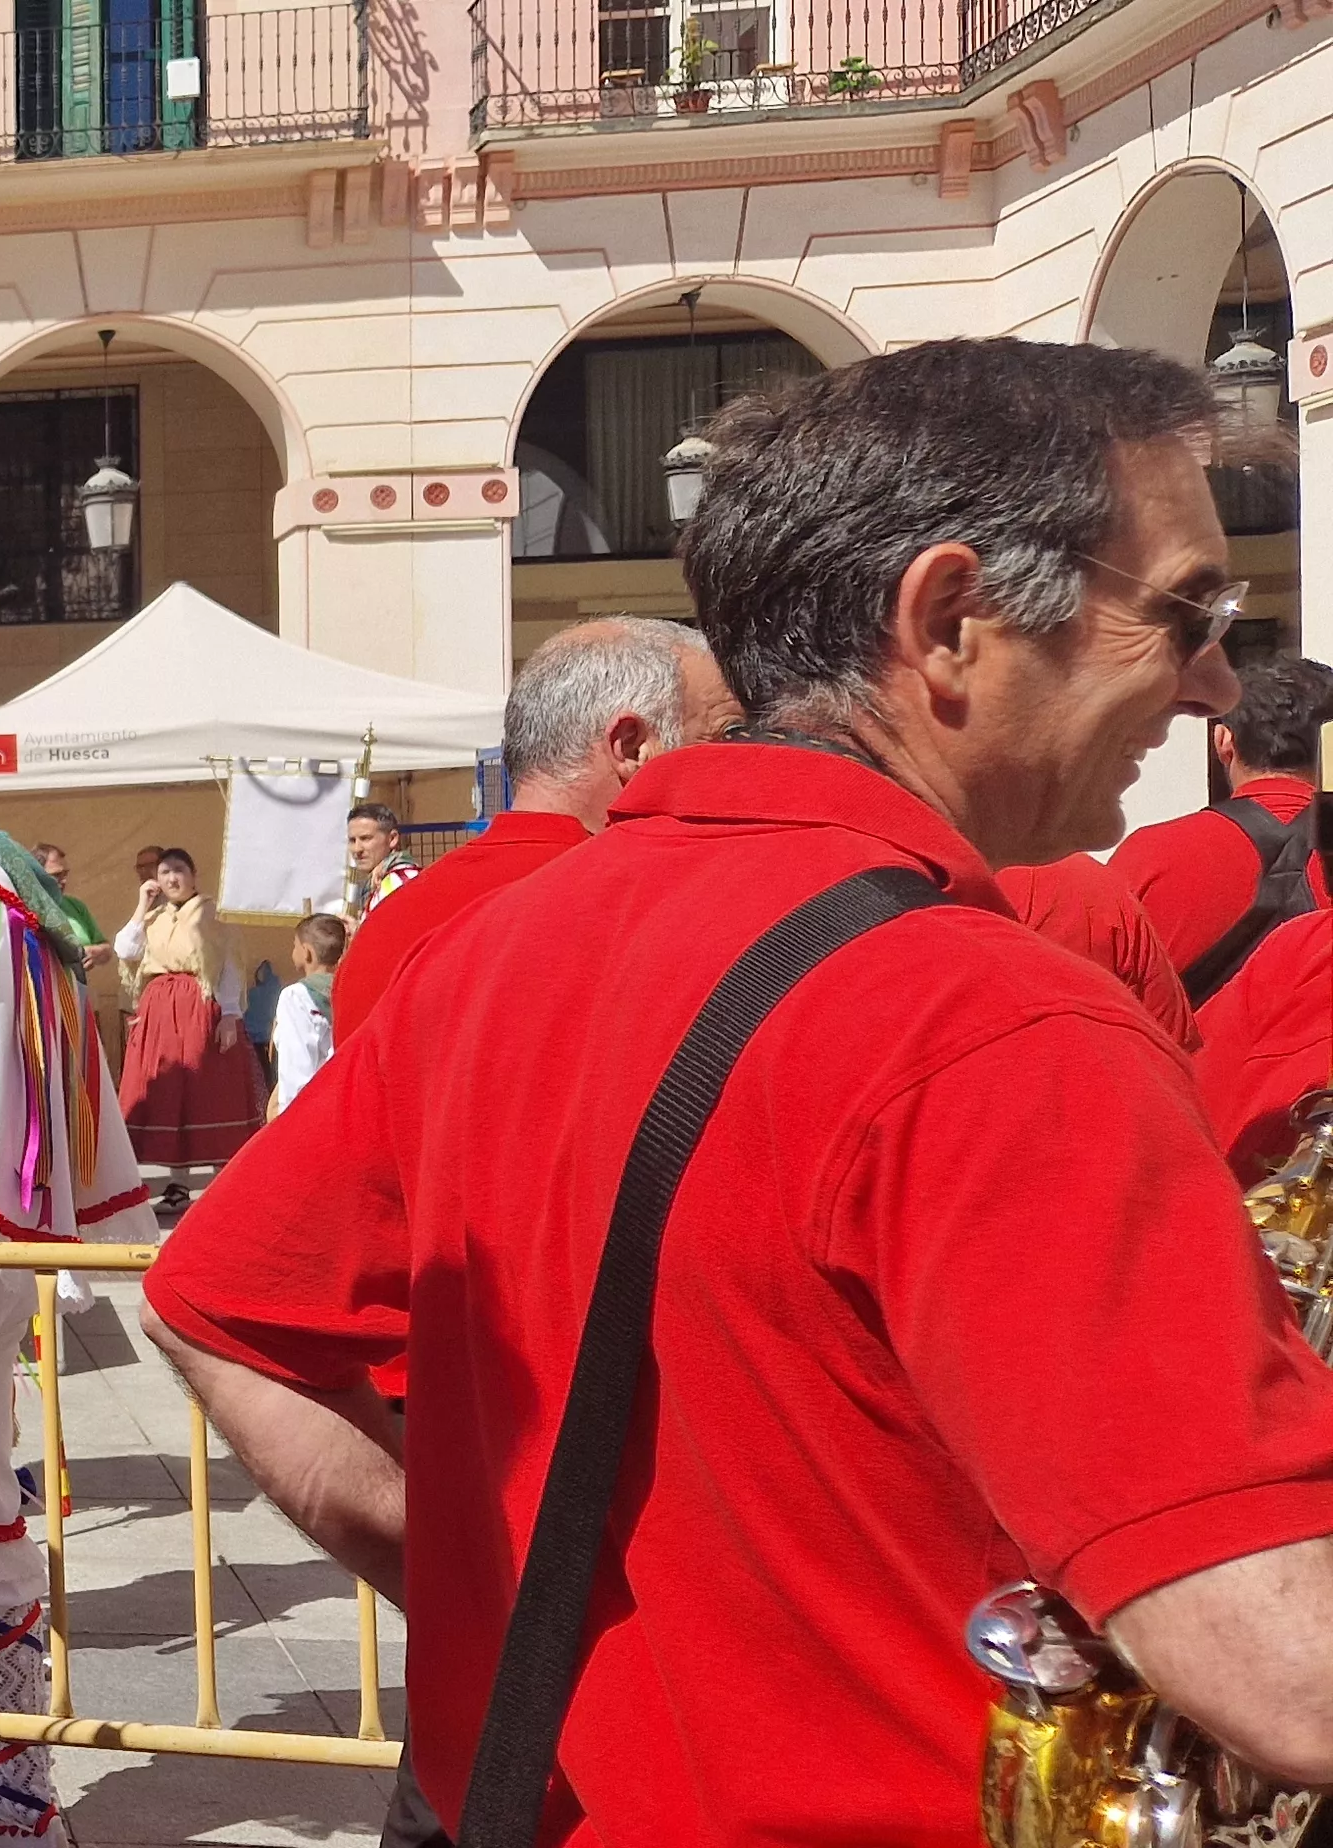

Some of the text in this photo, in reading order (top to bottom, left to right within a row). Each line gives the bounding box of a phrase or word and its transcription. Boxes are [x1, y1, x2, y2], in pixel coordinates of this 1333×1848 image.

[23, 729, 138, 746] Ayuntamiento
[24, 748, 110, 763] de Huesca
